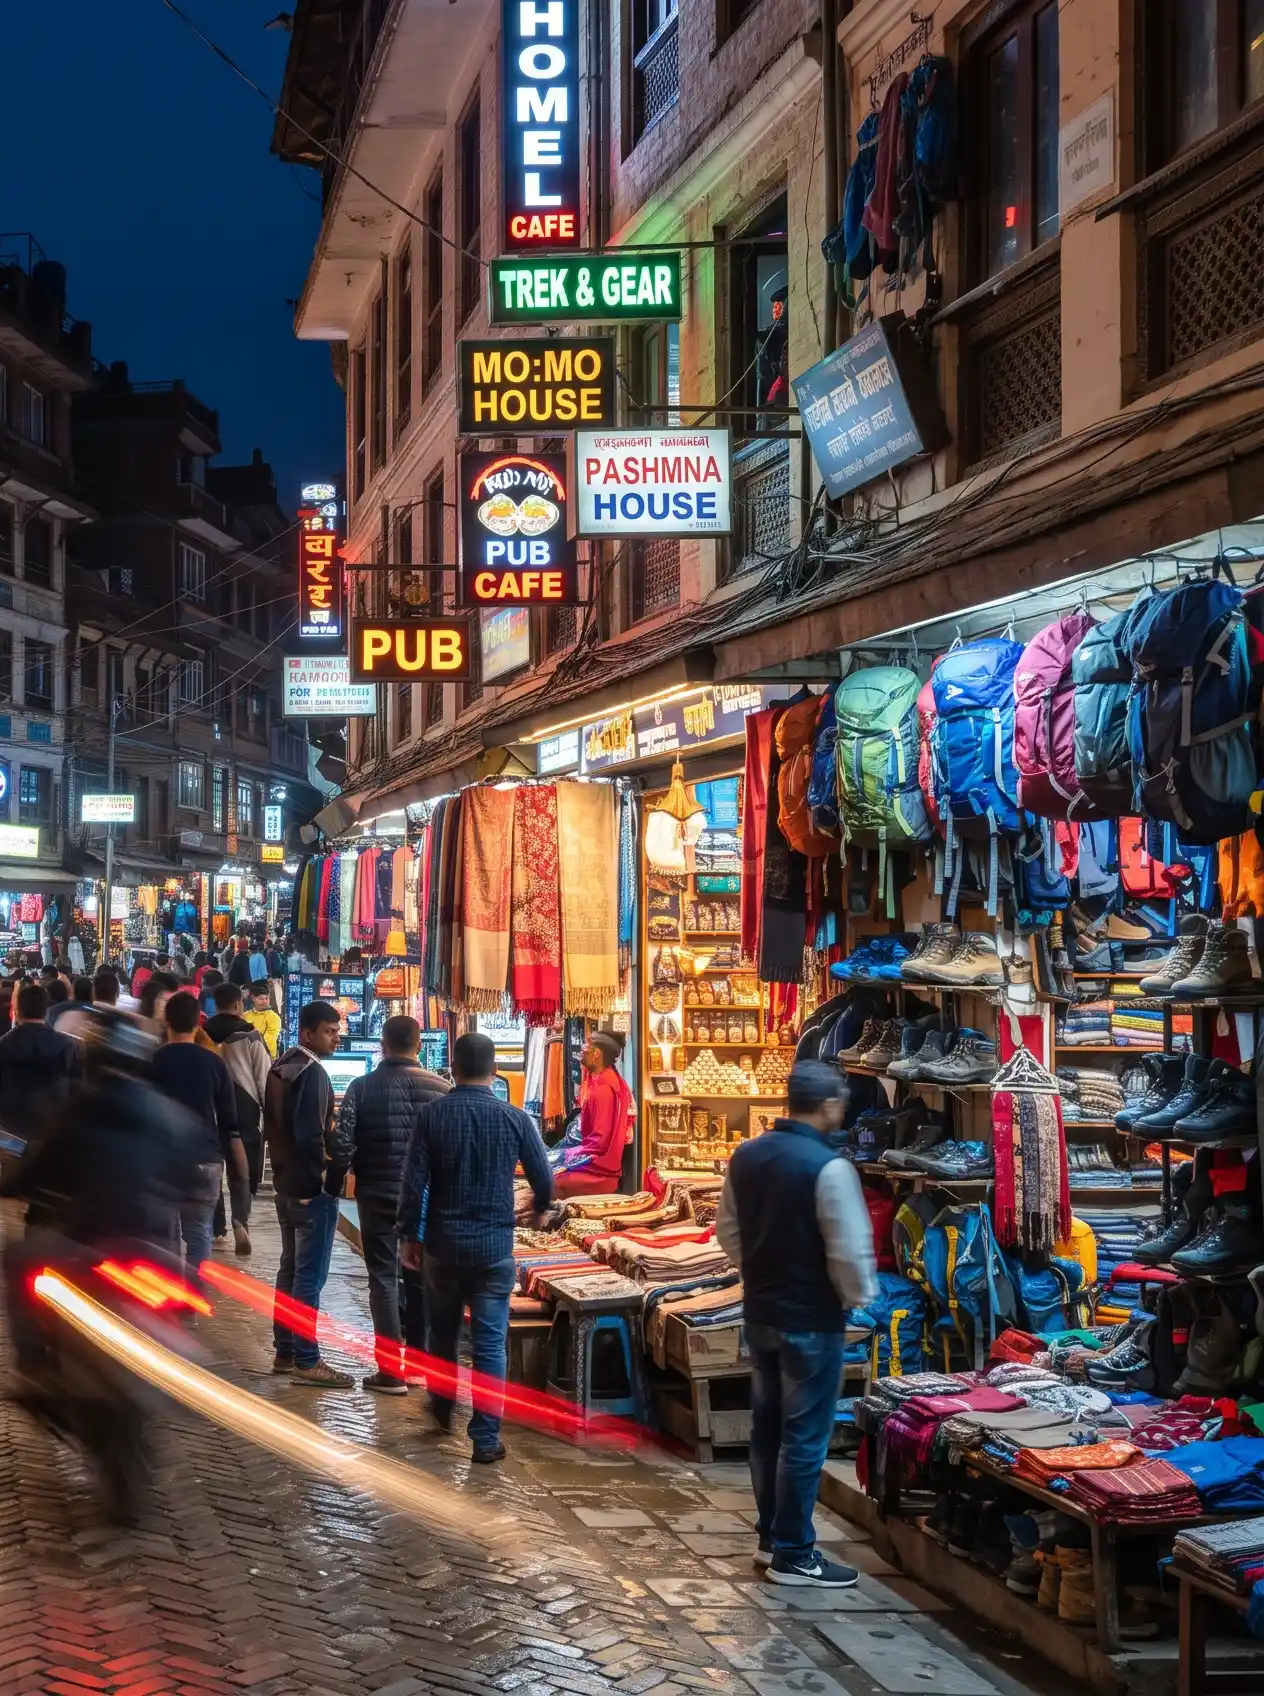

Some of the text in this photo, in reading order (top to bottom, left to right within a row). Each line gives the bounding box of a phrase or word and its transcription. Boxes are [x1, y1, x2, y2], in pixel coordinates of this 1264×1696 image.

[511, 215, 574, 238] CAFE
[499, 265, 673, 308] TREK & GEAR
[473, 349, 602, 384] MO:MO
[474, 388, 602, 422] HOUSE
[586, 455, 722, 485] PASHMNA
[594, 491, 717, 520] HOUSE
[486, 541, 550, 566] PUB
[475, 572, 562, 599] CAFE
[362, 629, 463, 671] PUB
